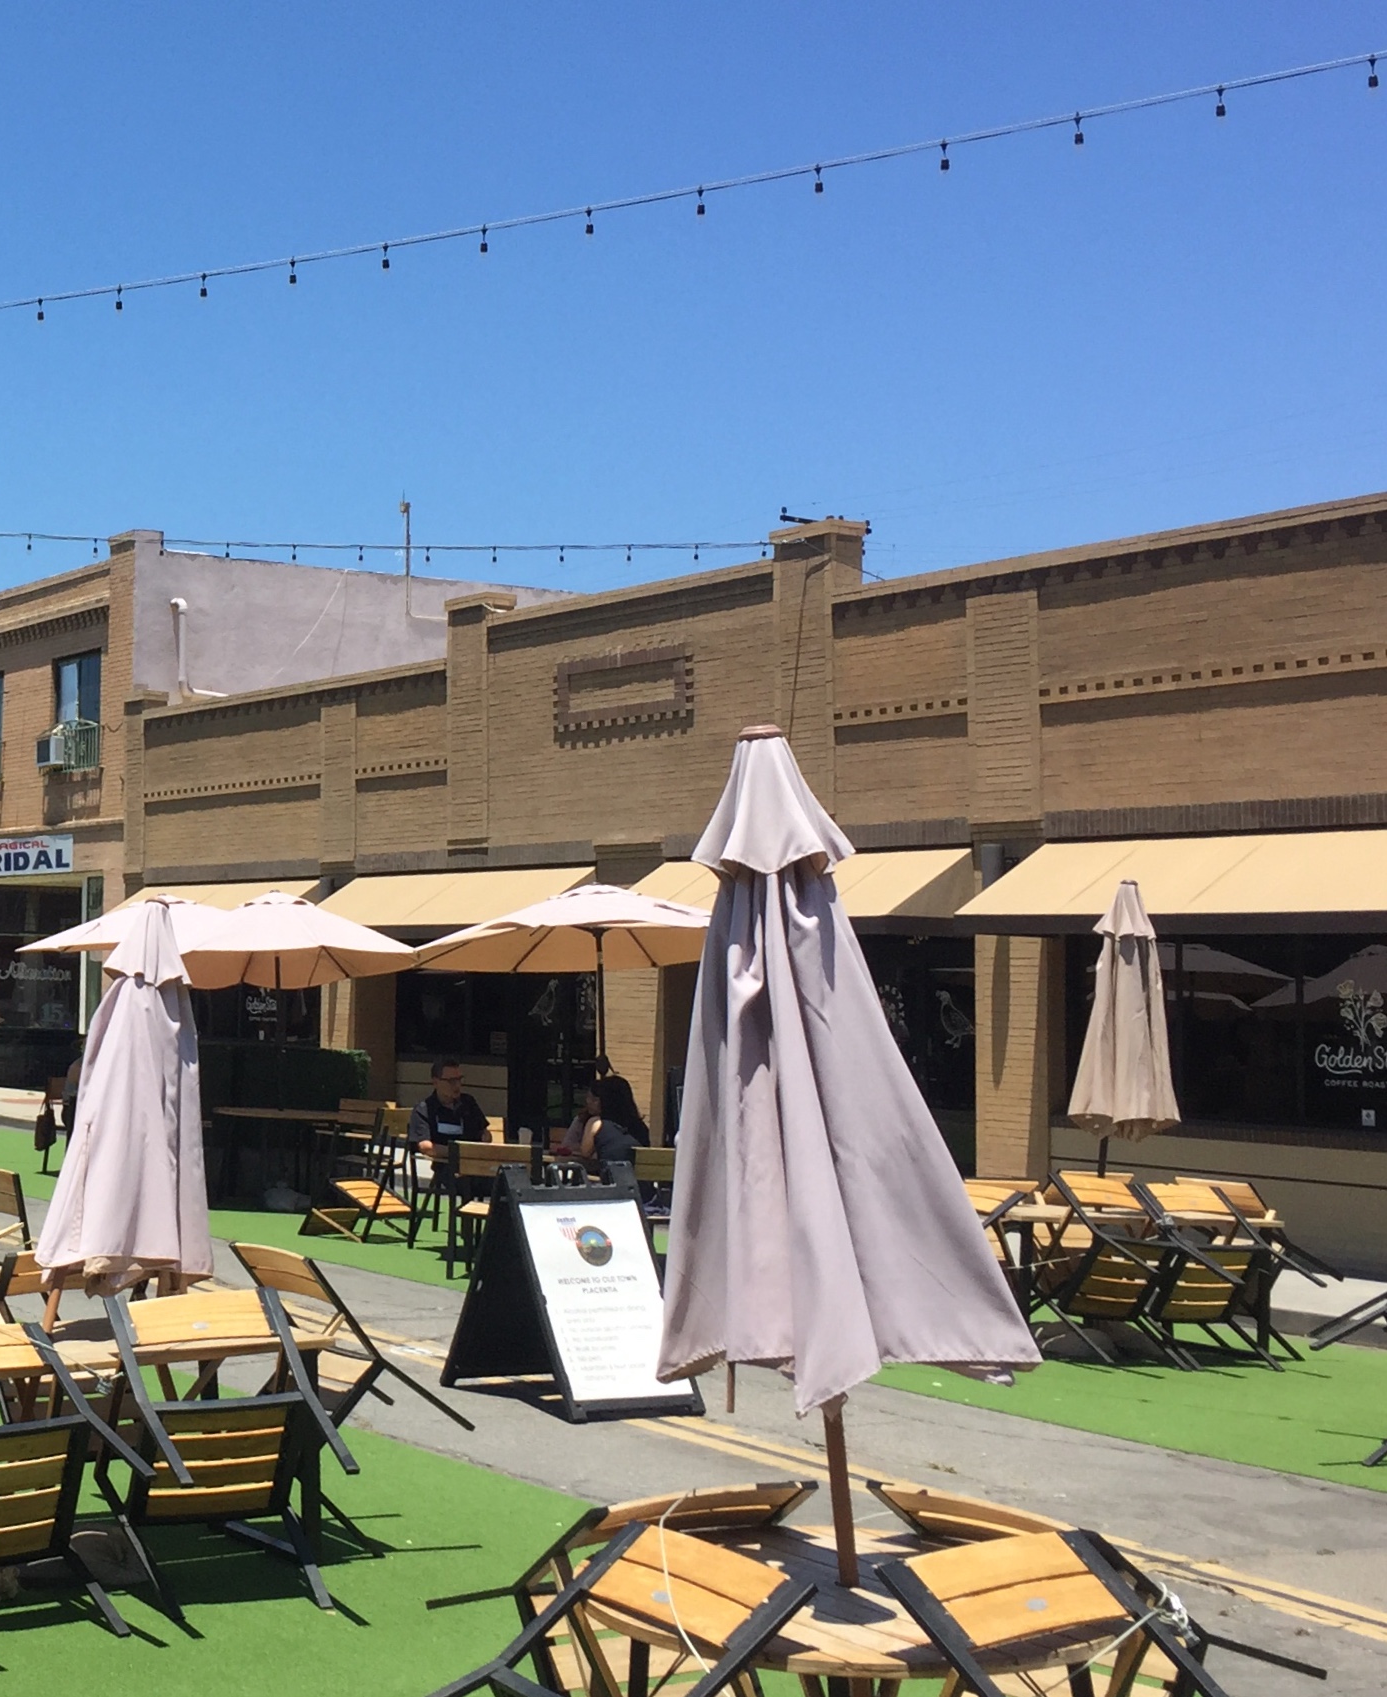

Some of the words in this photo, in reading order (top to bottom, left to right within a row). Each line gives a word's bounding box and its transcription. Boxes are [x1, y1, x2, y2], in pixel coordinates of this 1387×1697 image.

[1315, 1044, 1374, 1074] Golden
[1324, 1079, 1358, 1088] COFFEE
[1362, 1080, 1387, 1089] ROAS
[557, 1276, 591, 1285] WELCOME
[617, 1274, 638, 1282] TOWN
[582, 1286, 618, 1294] PLACENTIA
